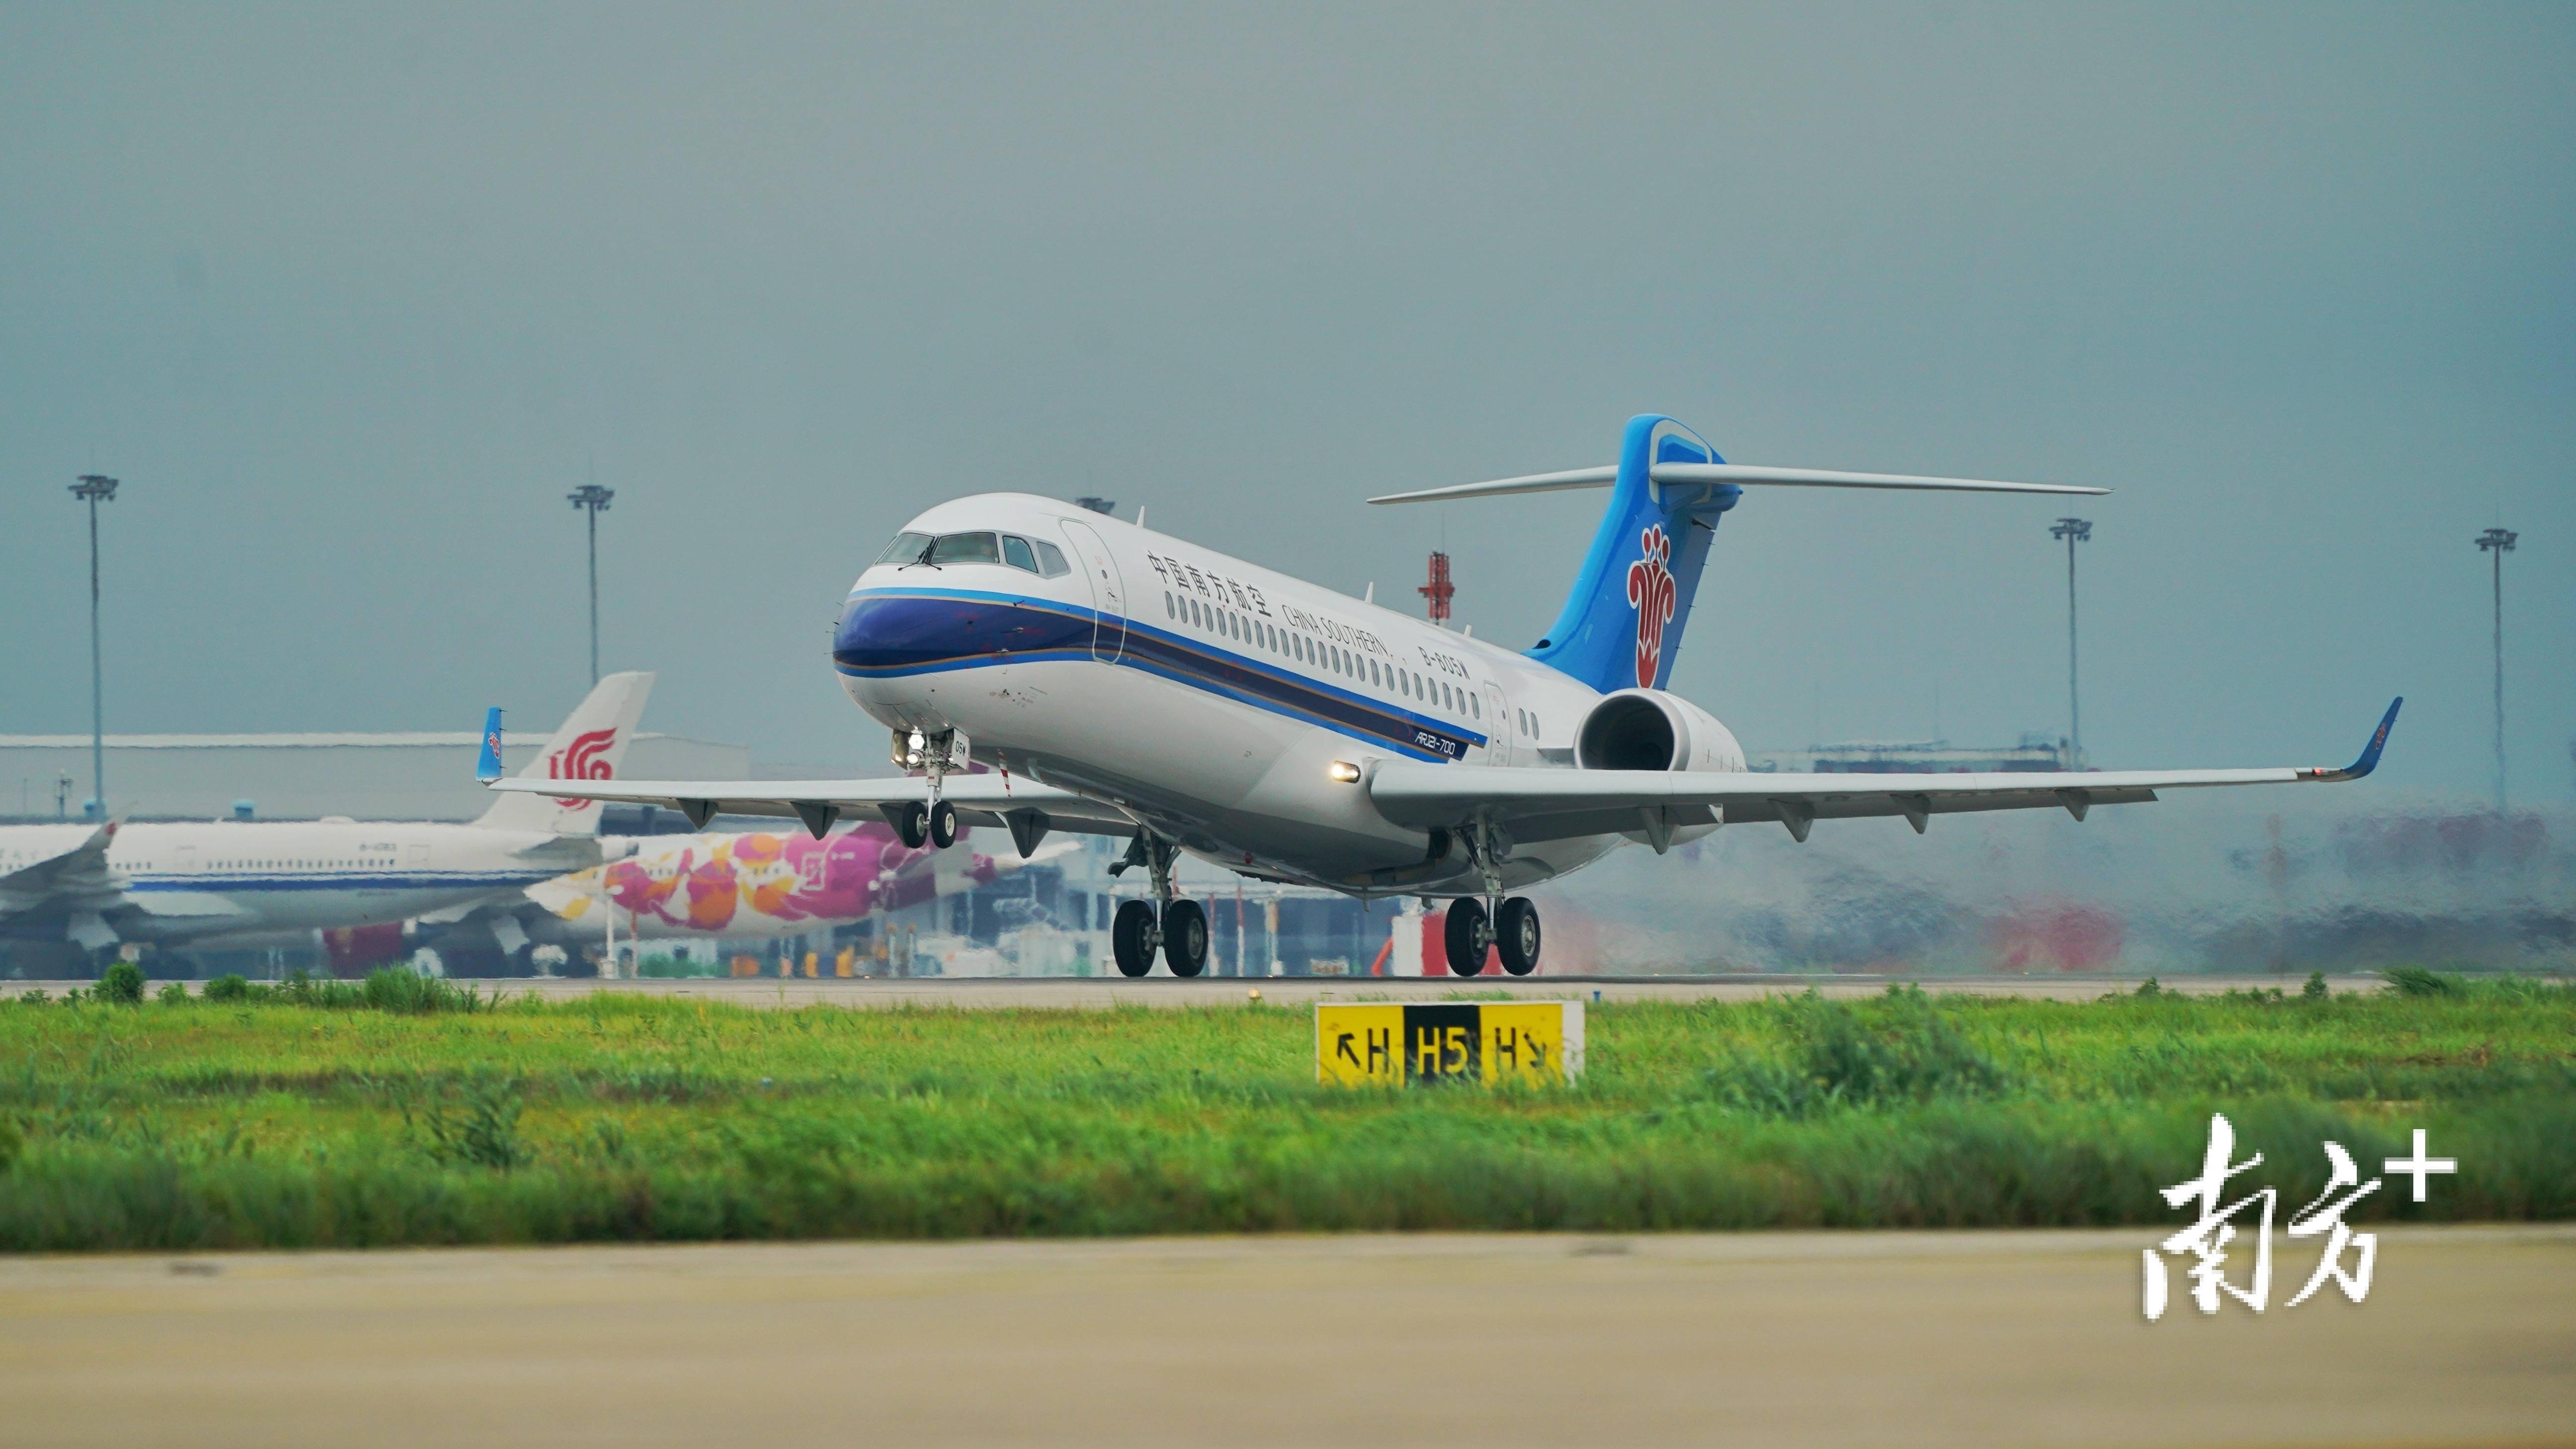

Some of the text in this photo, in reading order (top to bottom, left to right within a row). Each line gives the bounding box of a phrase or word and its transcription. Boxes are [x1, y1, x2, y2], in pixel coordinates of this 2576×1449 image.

[1147, 550, 1272, 617] 中国南方航空
[1282, 604, 1389, 657] CHINA SOUTHERN
[1414, 731, 1456, 755] ARJ21-700
[1367, 1027, 1389, 1074] H
[1417, 1026, 1469, 1075] H5
